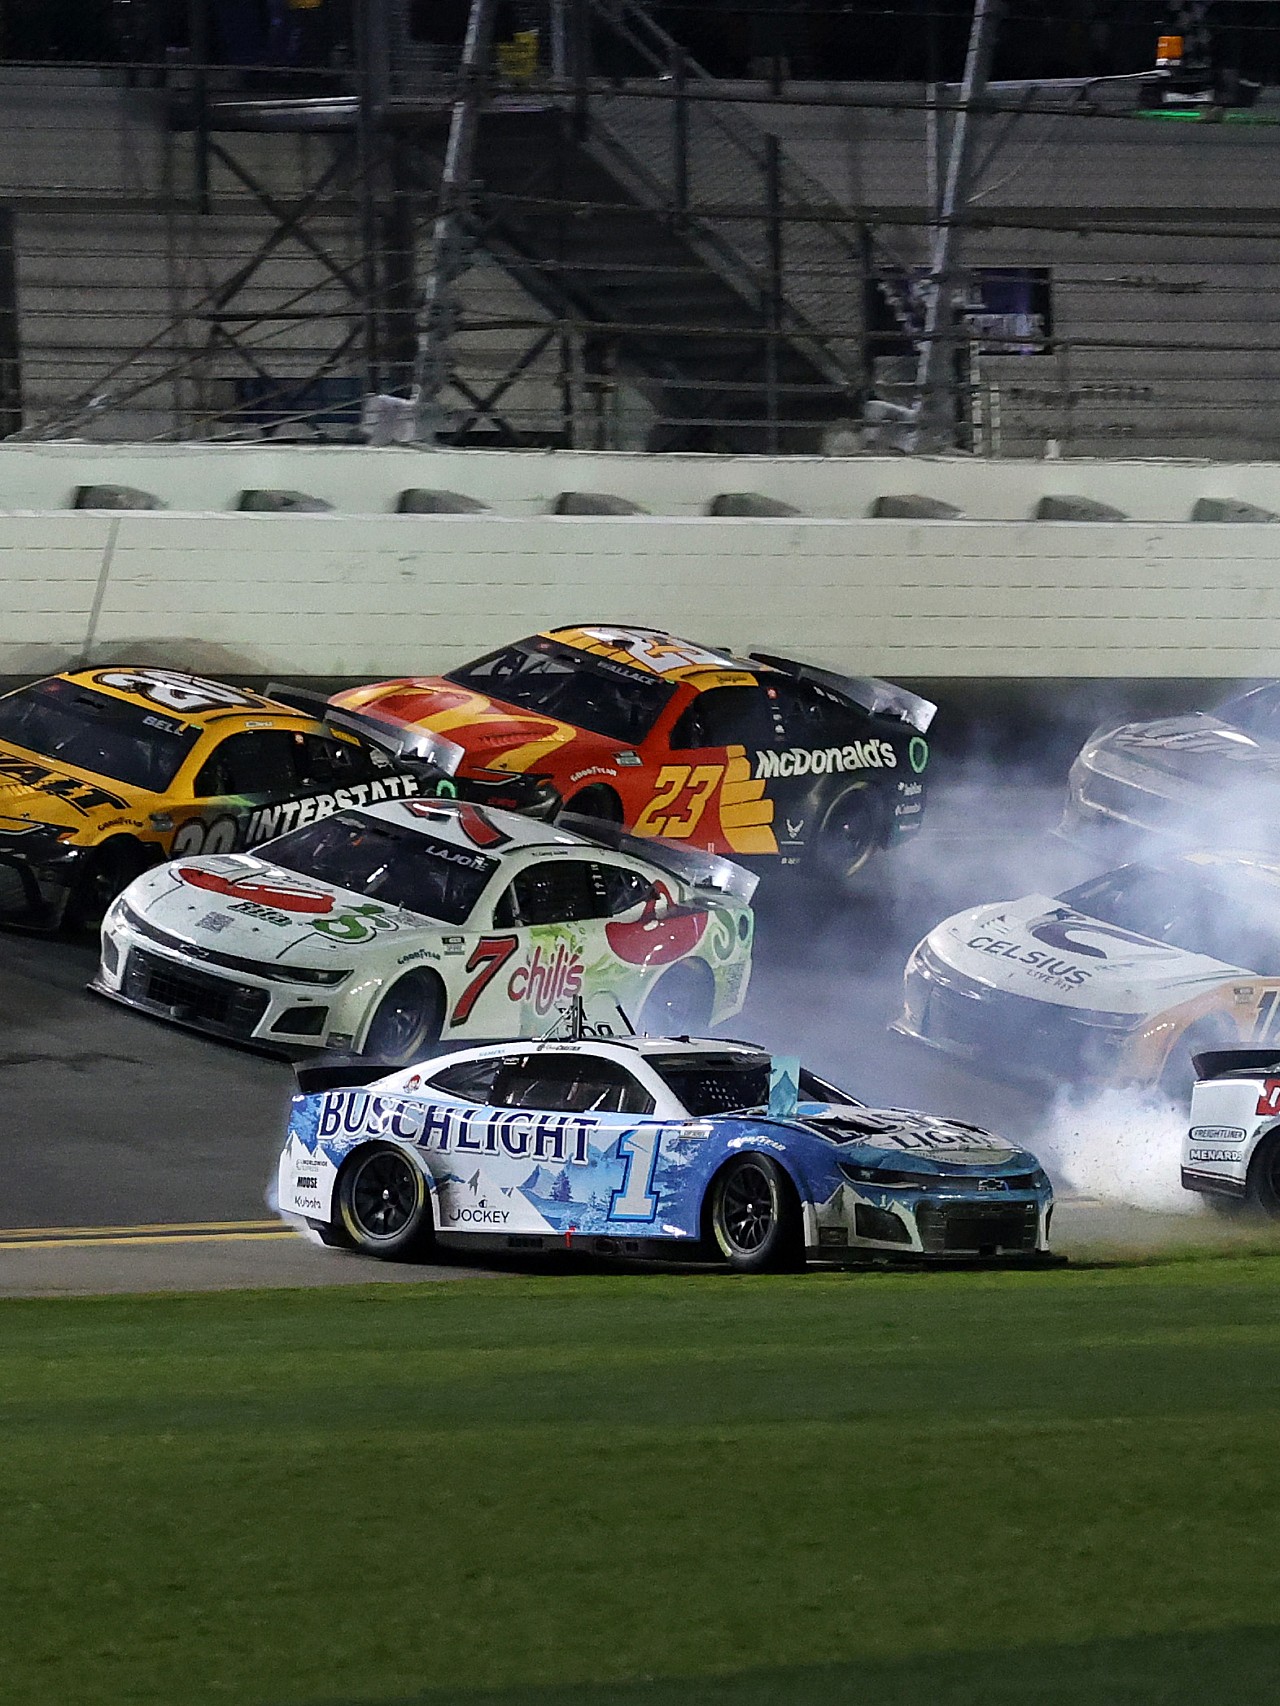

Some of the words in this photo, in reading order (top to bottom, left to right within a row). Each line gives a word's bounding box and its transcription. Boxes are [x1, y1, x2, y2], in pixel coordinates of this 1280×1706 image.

[143, 716, 184, 737] BELL
[754, 738, 899, 779] McDonald's
[246, 774, 420, 844] INTERSTATE
[630, 765, 725, 838] 23
[450, 934, 519, 1027] 7
[508, 944, 585, 1016] chili's
[966, 936, 1093, 985] CELSIUS
[606, 1120, 671, 1224] 1
[1189, 1149, 1244, 1162] MENARDS
[294, 1195, 322, 1210] Kubota
[296, 1176, 319, 1189] MOOSE
[449, 1208, 511, 1224] JOCKEY
